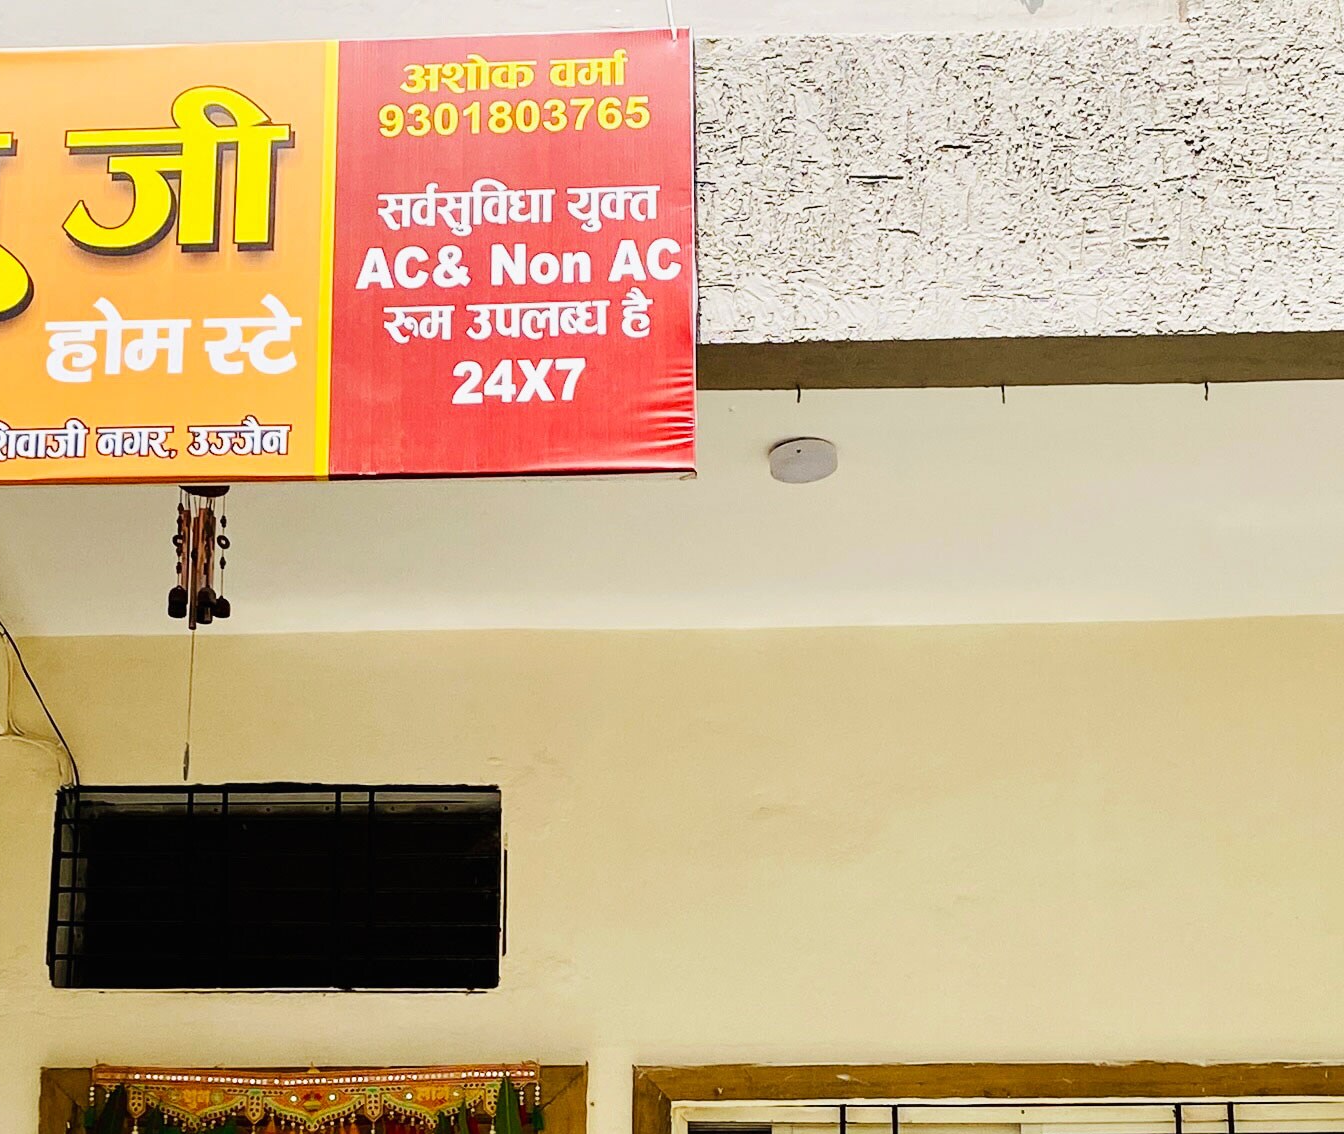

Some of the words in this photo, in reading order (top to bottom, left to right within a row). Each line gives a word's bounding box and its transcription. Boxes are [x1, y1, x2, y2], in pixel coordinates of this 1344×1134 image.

[400, 55, 537, 93] अशोक
[549, 49, 629, 87] वर्मा
[378, 95, 651, 138] 9301803765
[62, 86, 295, 255] जी
[377, 178, 555, 237] सर्वसुविधा
[566, 185, 661, 232] युक्त
[355, 245, 471, 290] AC&
[490, 244, 592, 286] Non
[608, 238, 682, 283] AC
[44, 297, 192, 383] होम
[203, 293, 303, 375] स्टे
[383, 305, 455, 344] रूम
[466, 299, 610, 340] उपलब्ध
[621, 287, 654, 338] है
[451, 357, 586, 405] 24X7
[96, 426, 175, 459] नगर,
[187, 416, 291, 457] उज्जैन
